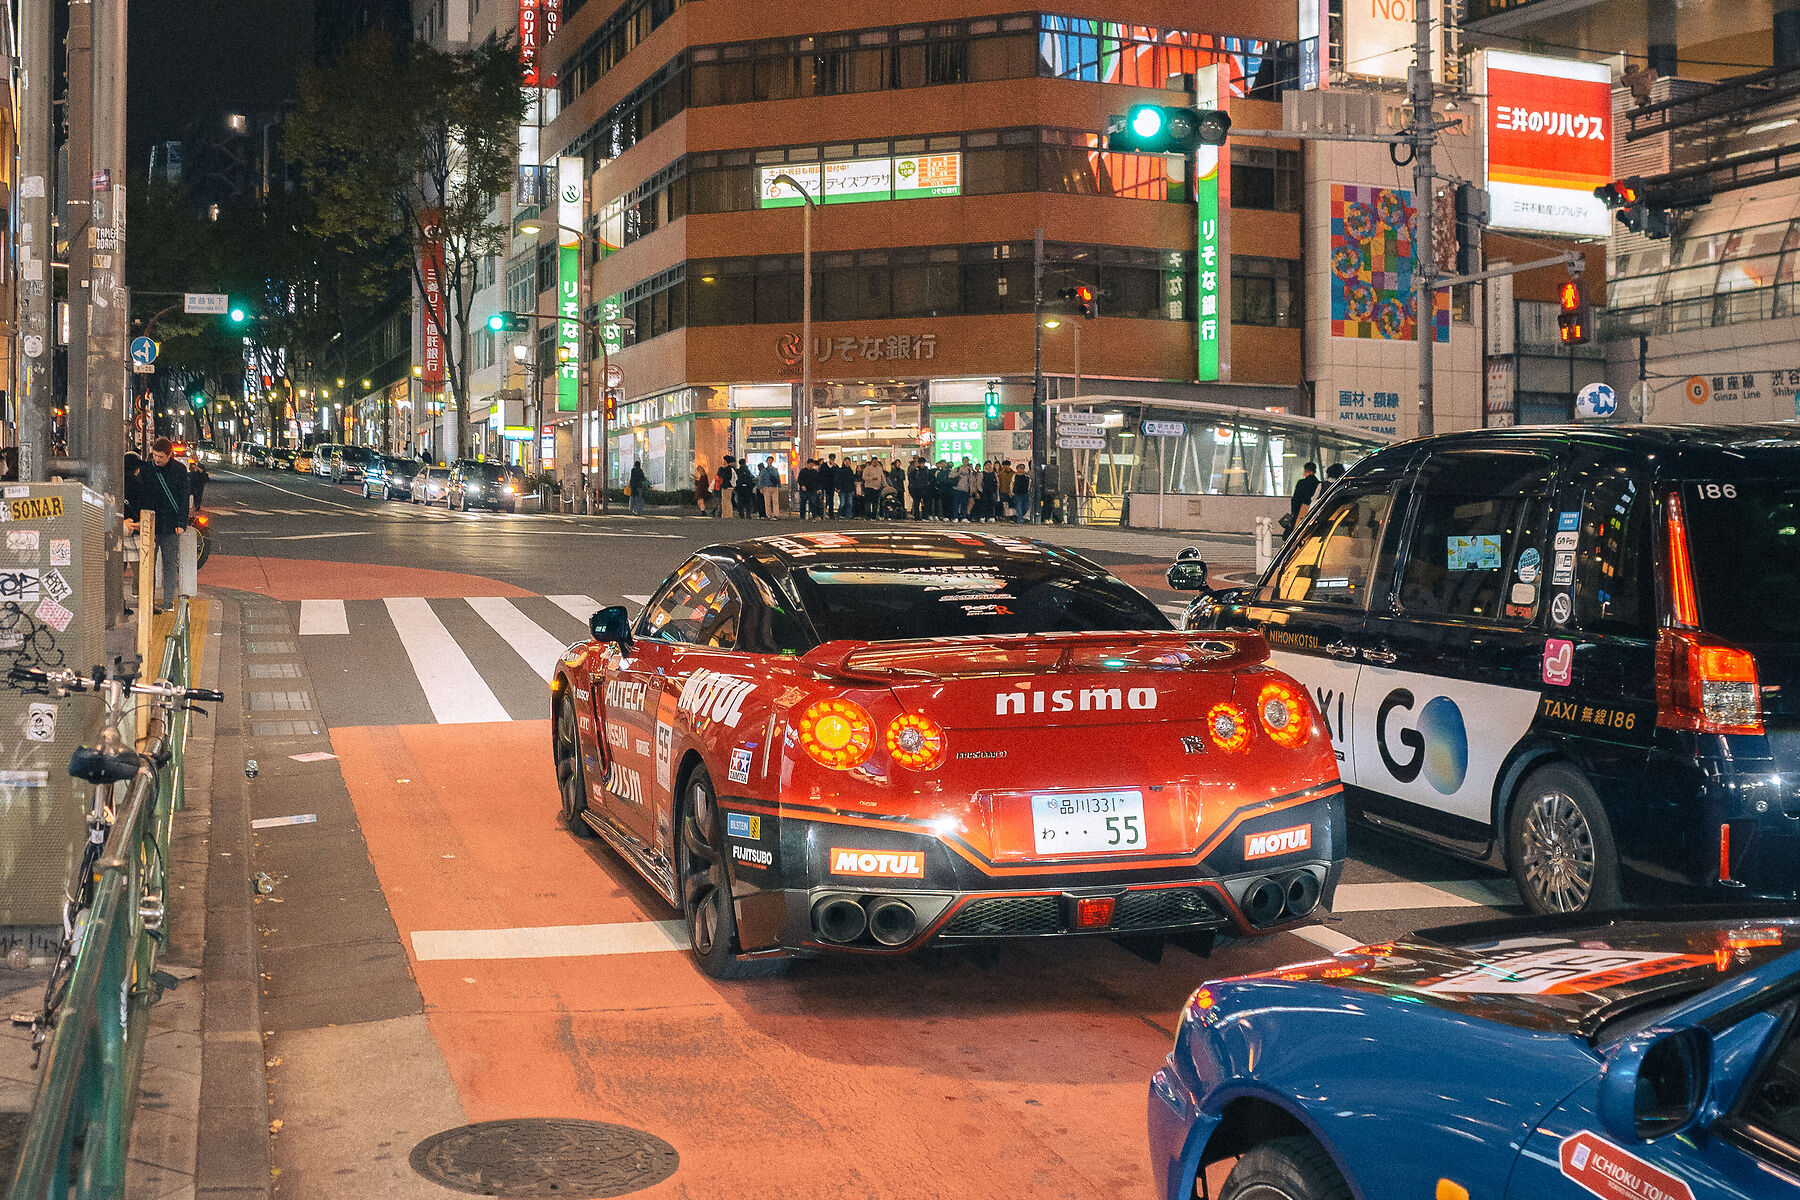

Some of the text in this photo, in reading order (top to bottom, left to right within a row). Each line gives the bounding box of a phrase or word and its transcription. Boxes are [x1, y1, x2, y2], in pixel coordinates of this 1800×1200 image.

[1496, 106, 1605, 141] 三井のリハウス
[1513, 201, 1588, 217] 三井不動産リアルティ
[1202, 220, 1216, 341] りそな銀行
[814, 334, 936, 362] りそな銀行
[1713, 391, 1761, 401] Ginza Line
[940, 421, 979, 431] りそなの
[1339, 412, 1396, 421] ART MATERIALS
[1697, 484, 1737, 499] 186
[12, 496, 62, 520] SONAR
[1269, 630, 1318, 649] NIHONKOTSU
[605, 680, 647, 711] AUTECH
[678, 667, 757, 728] MOTUL
[1544, 699, 1577, 720] TAXI
[1042, 827, 1056, 839] わ
[1105, 816, 1139, 845] 55
[1248, 829, 1308, 856] MOTUL
[732, 845, 773, 866] FUJITSUBO
[835, 853, 920, 874] MOTUL
[1592, 1153, 1641, 1190] ICHIOKU
